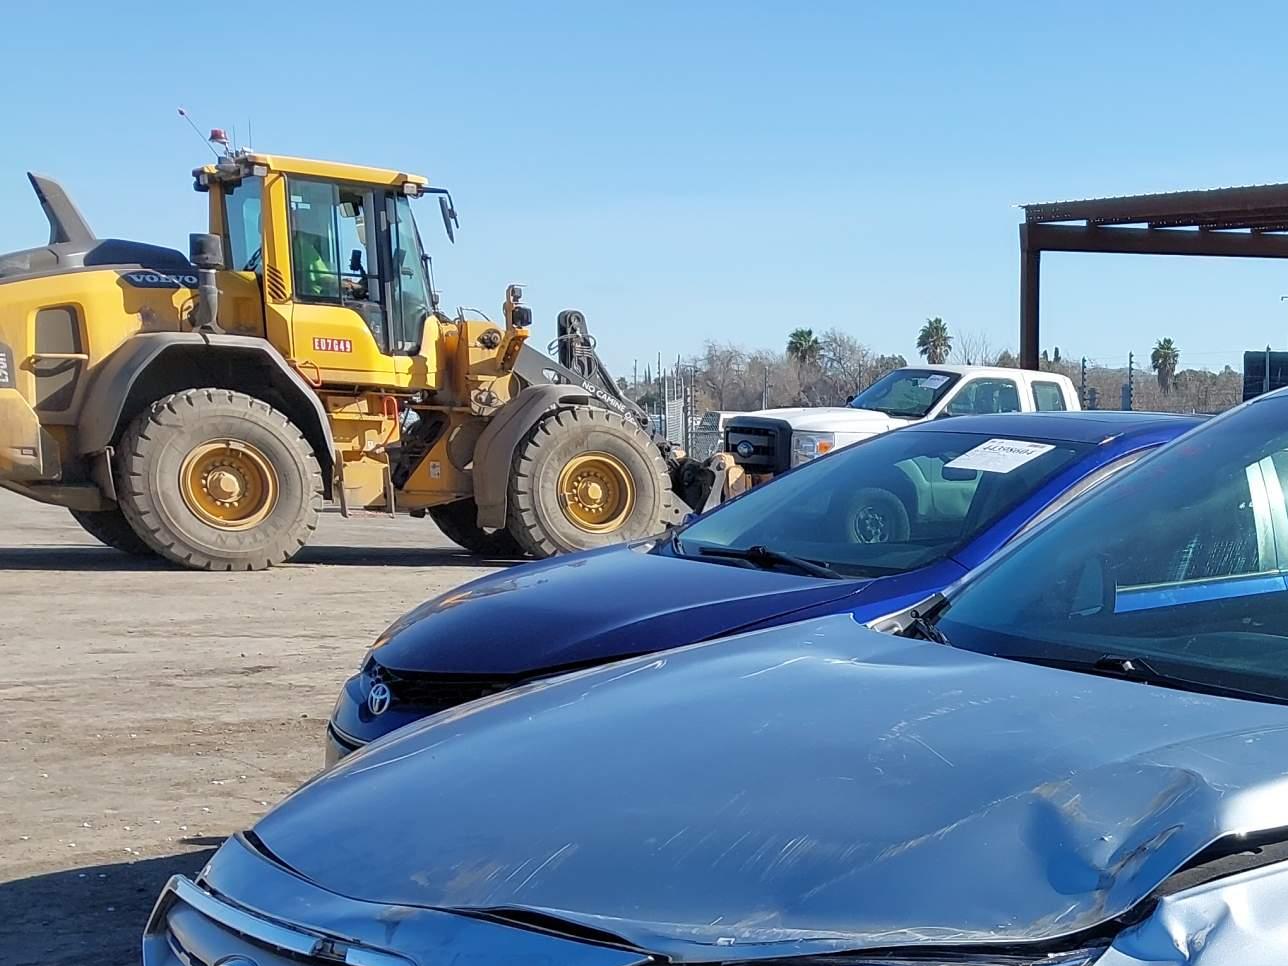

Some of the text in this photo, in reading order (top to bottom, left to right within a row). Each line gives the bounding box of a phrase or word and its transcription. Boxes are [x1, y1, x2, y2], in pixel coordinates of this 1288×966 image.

[127, 274, 198, 283] VOLVO
[582, 381, 596, 393] NO
[596, 390, 627, 413] CAMINE
